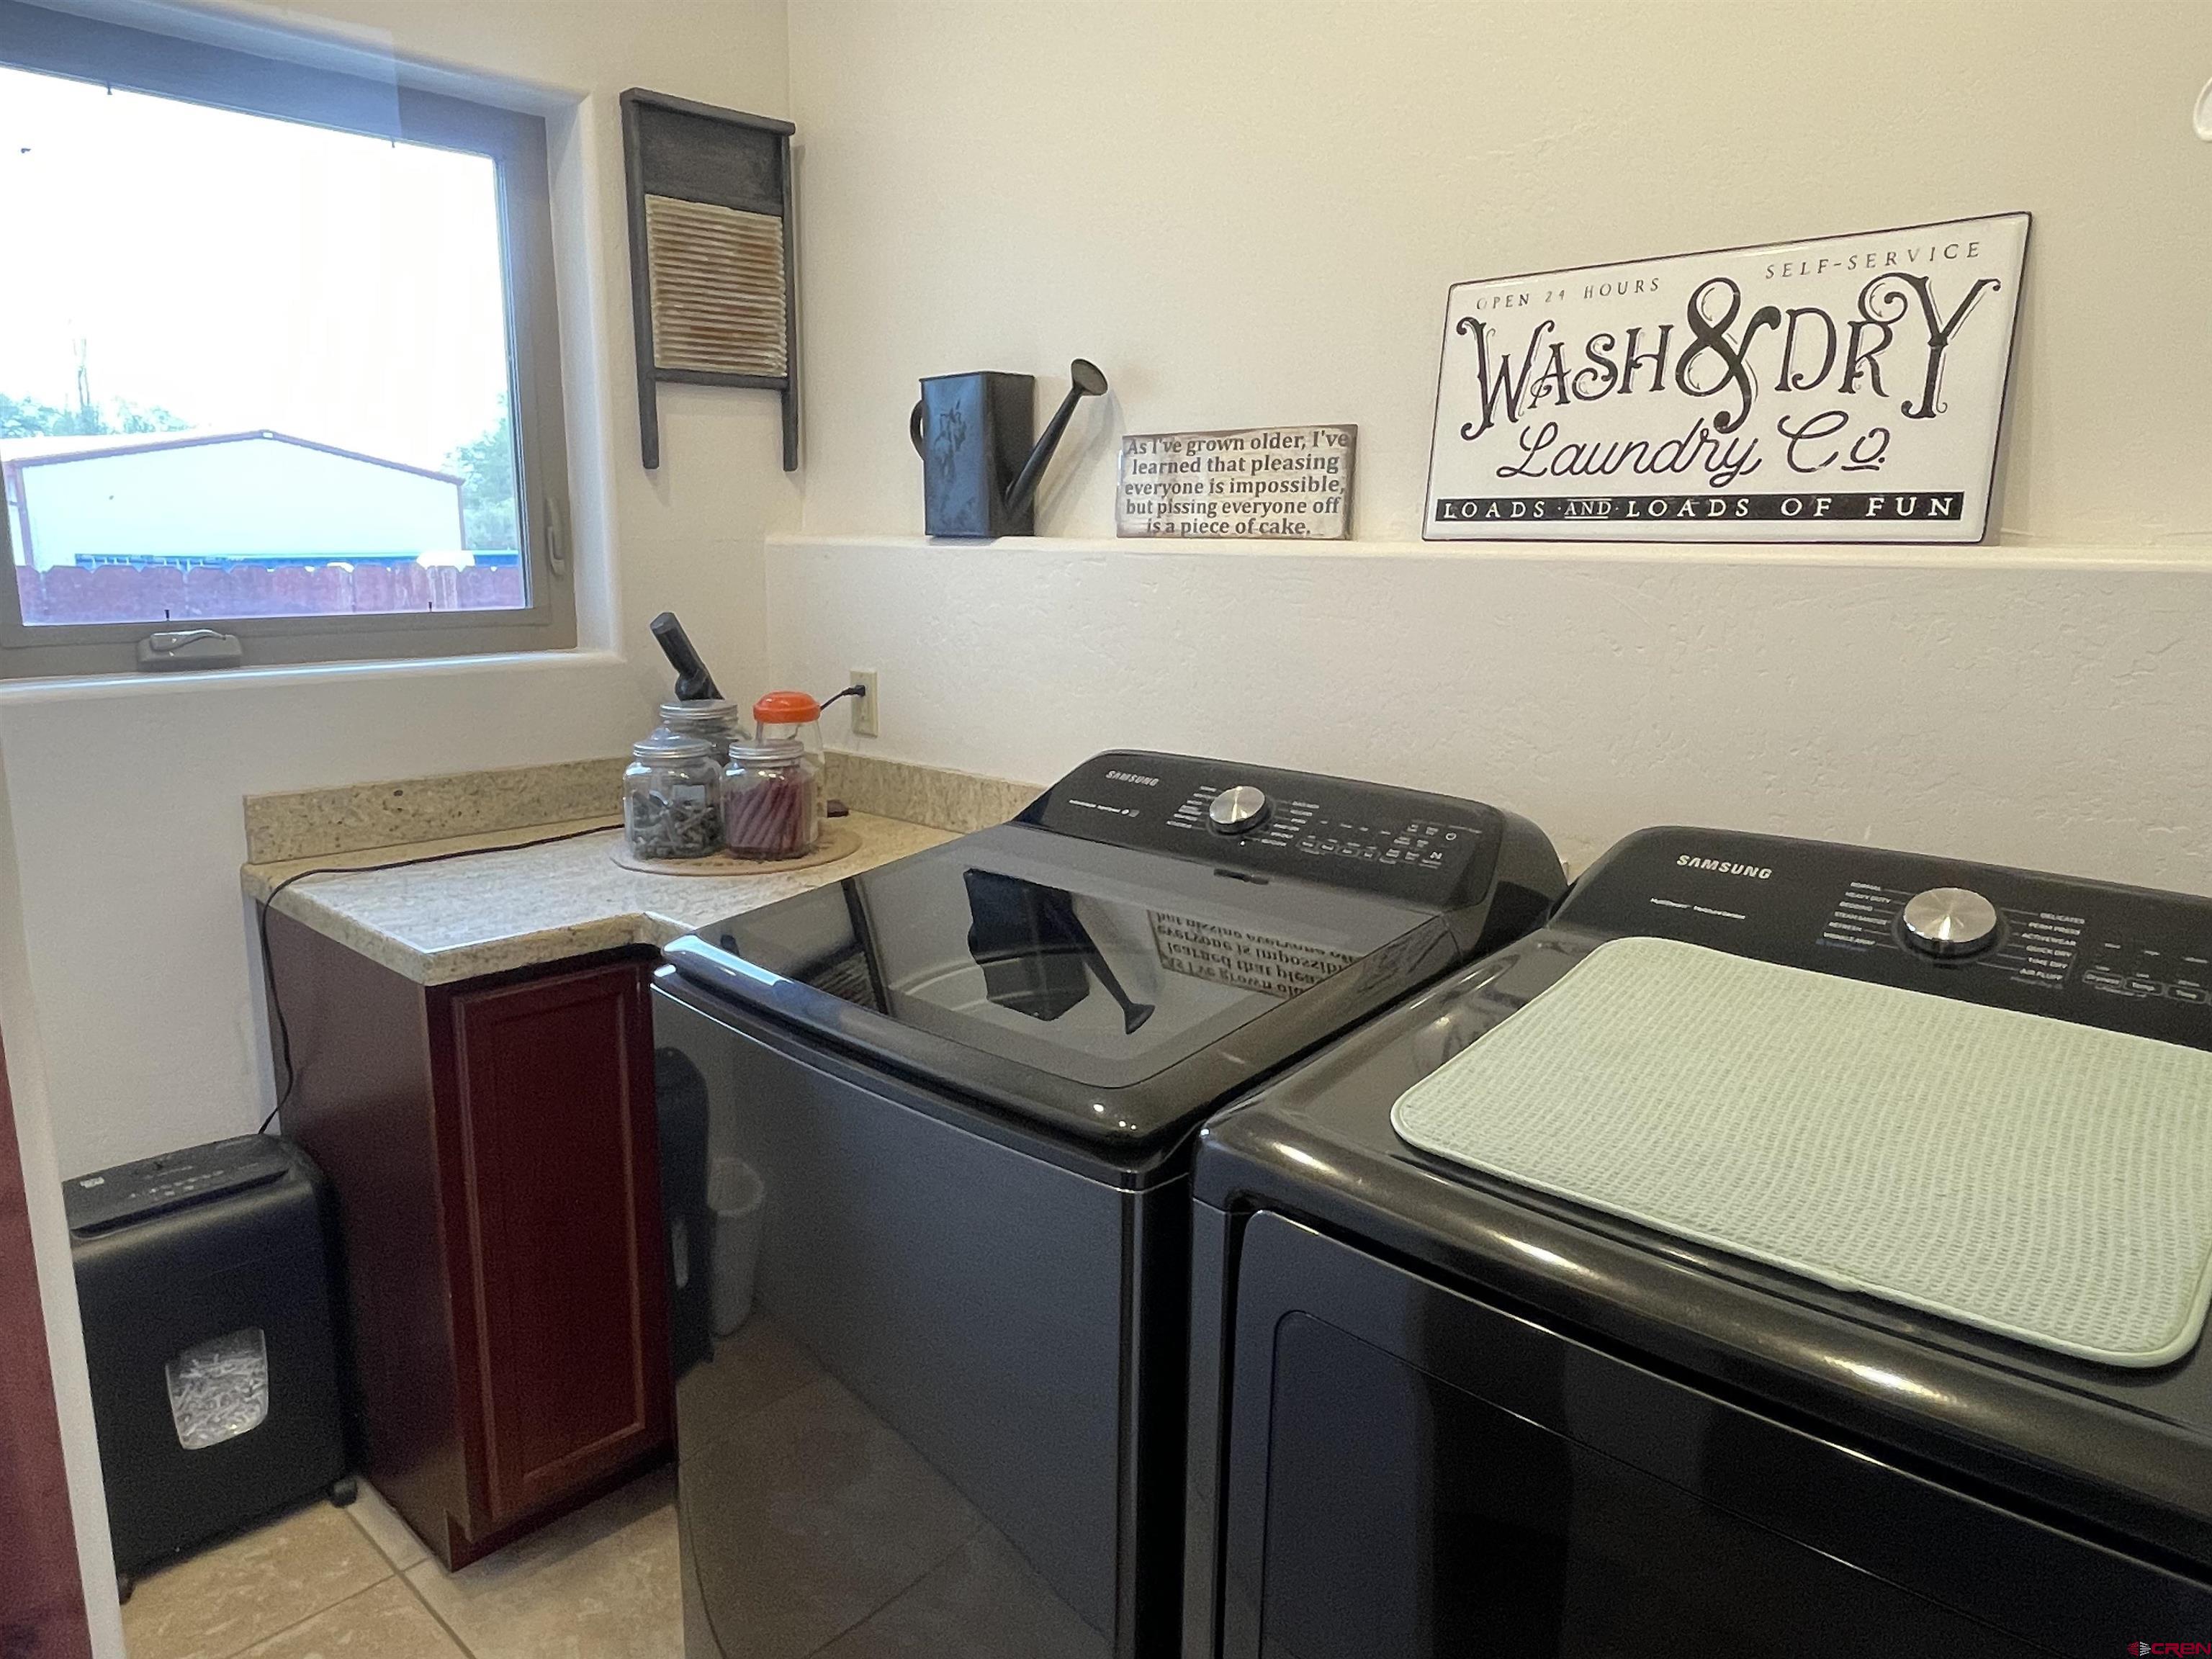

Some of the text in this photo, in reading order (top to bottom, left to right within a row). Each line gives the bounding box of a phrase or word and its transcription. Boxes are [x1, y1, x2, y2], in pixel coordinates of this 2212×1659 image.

[1765, 241, 1981, 280] SELF-SERVICE
[1476, 277, 1660, 310] OPEN 24 HOURS
[1456, 272, 2001, 441] WASH & DRY
[1126, 430, 1349, 457] As I've grown older, I've
[1496, 417, 1762, 488] Laundry
[1132, 454, 1340, 476] learned that pleasing
[1125, 475, 1345, 500] everyone is impossible,
[1126, 497, 1341, 518] but pissing everyone off
[1443, 496, 1954, 519] LOADS AND LOADS OF FUN
[1147, 518, 1311, 537] is a piece of cake.
[1105, 770, 1160, 788] SAMSUNG
[1676, 854, 1773, 880] SAMSUNG
